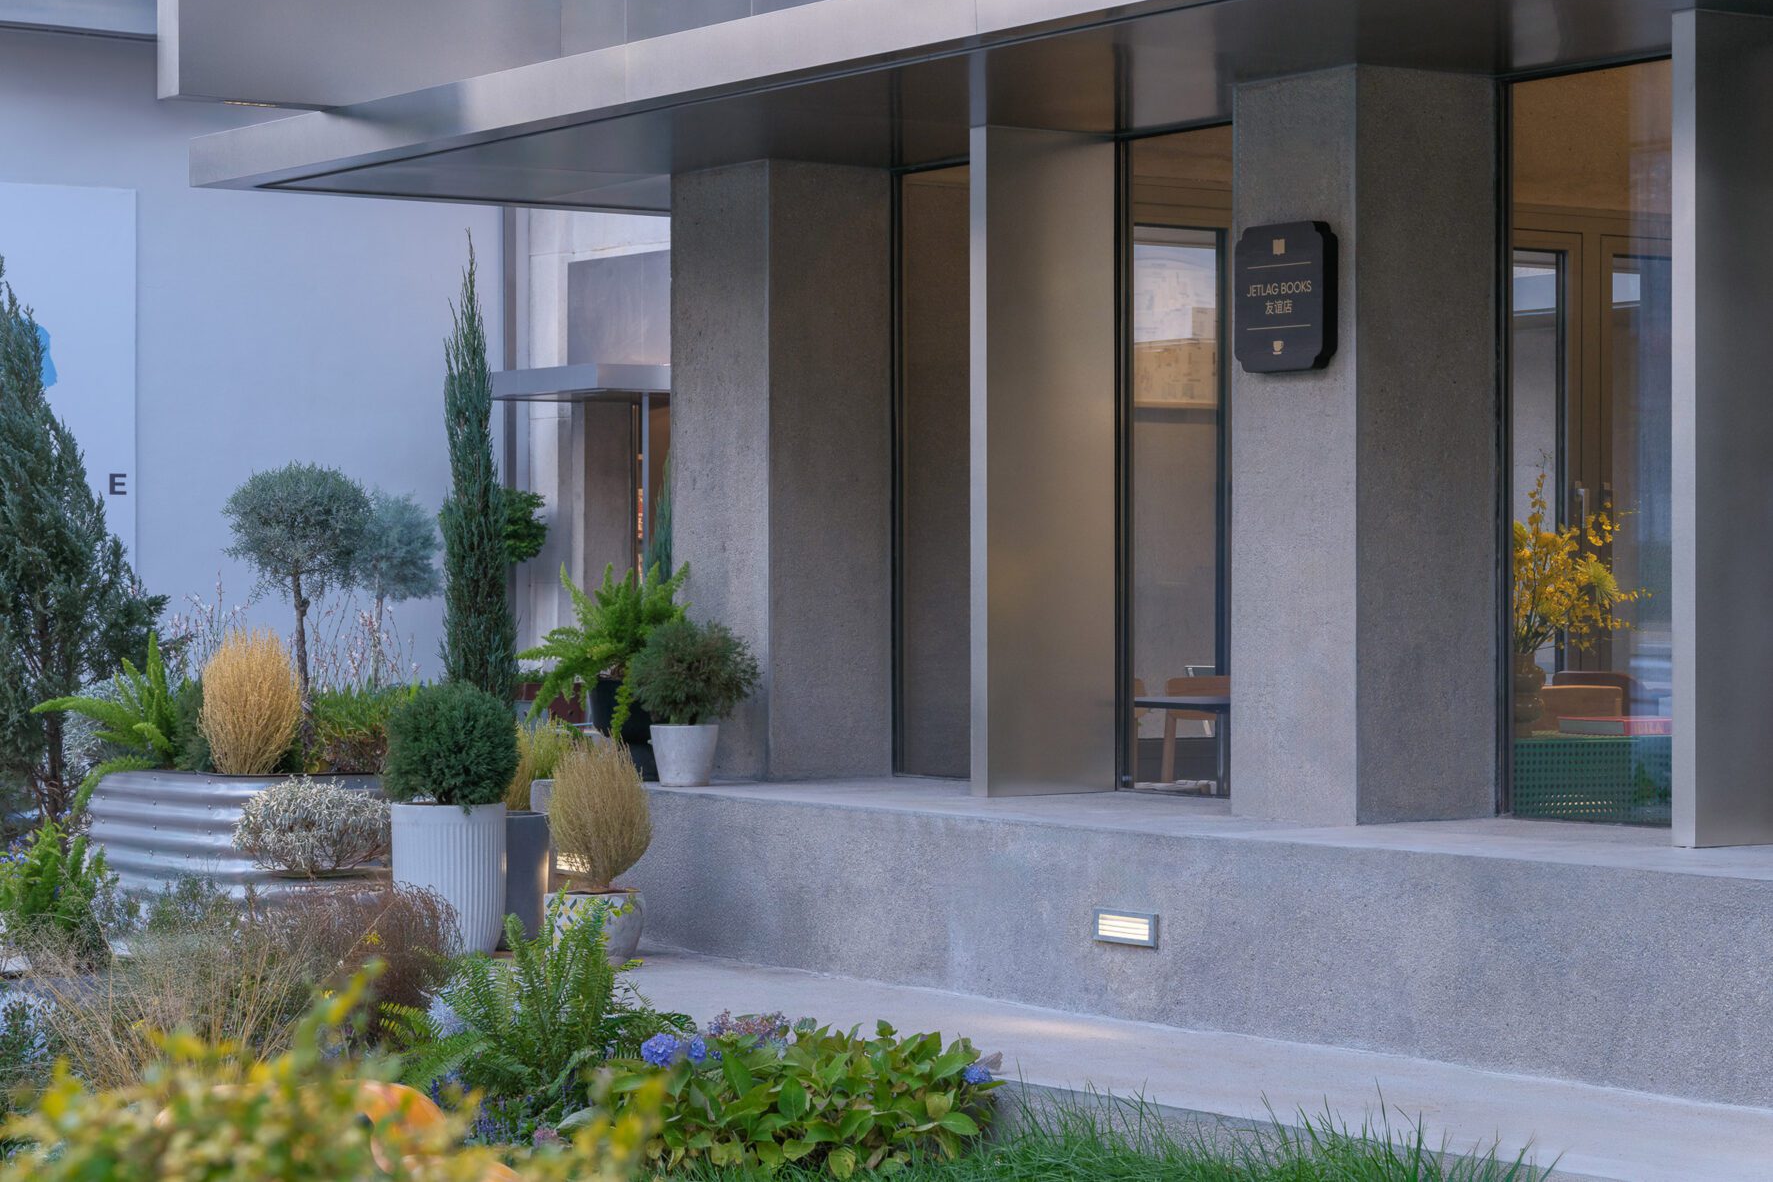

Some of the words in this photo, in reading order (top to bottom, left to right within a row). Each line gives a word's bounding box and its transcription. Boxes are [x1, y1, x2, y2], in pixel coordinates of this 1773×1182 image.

[1246, 282, 1279, 297] JETLAG
[1280, 280, 1312, 295] BOOKS
[1264, 299, 1293, 315] 友谊店
